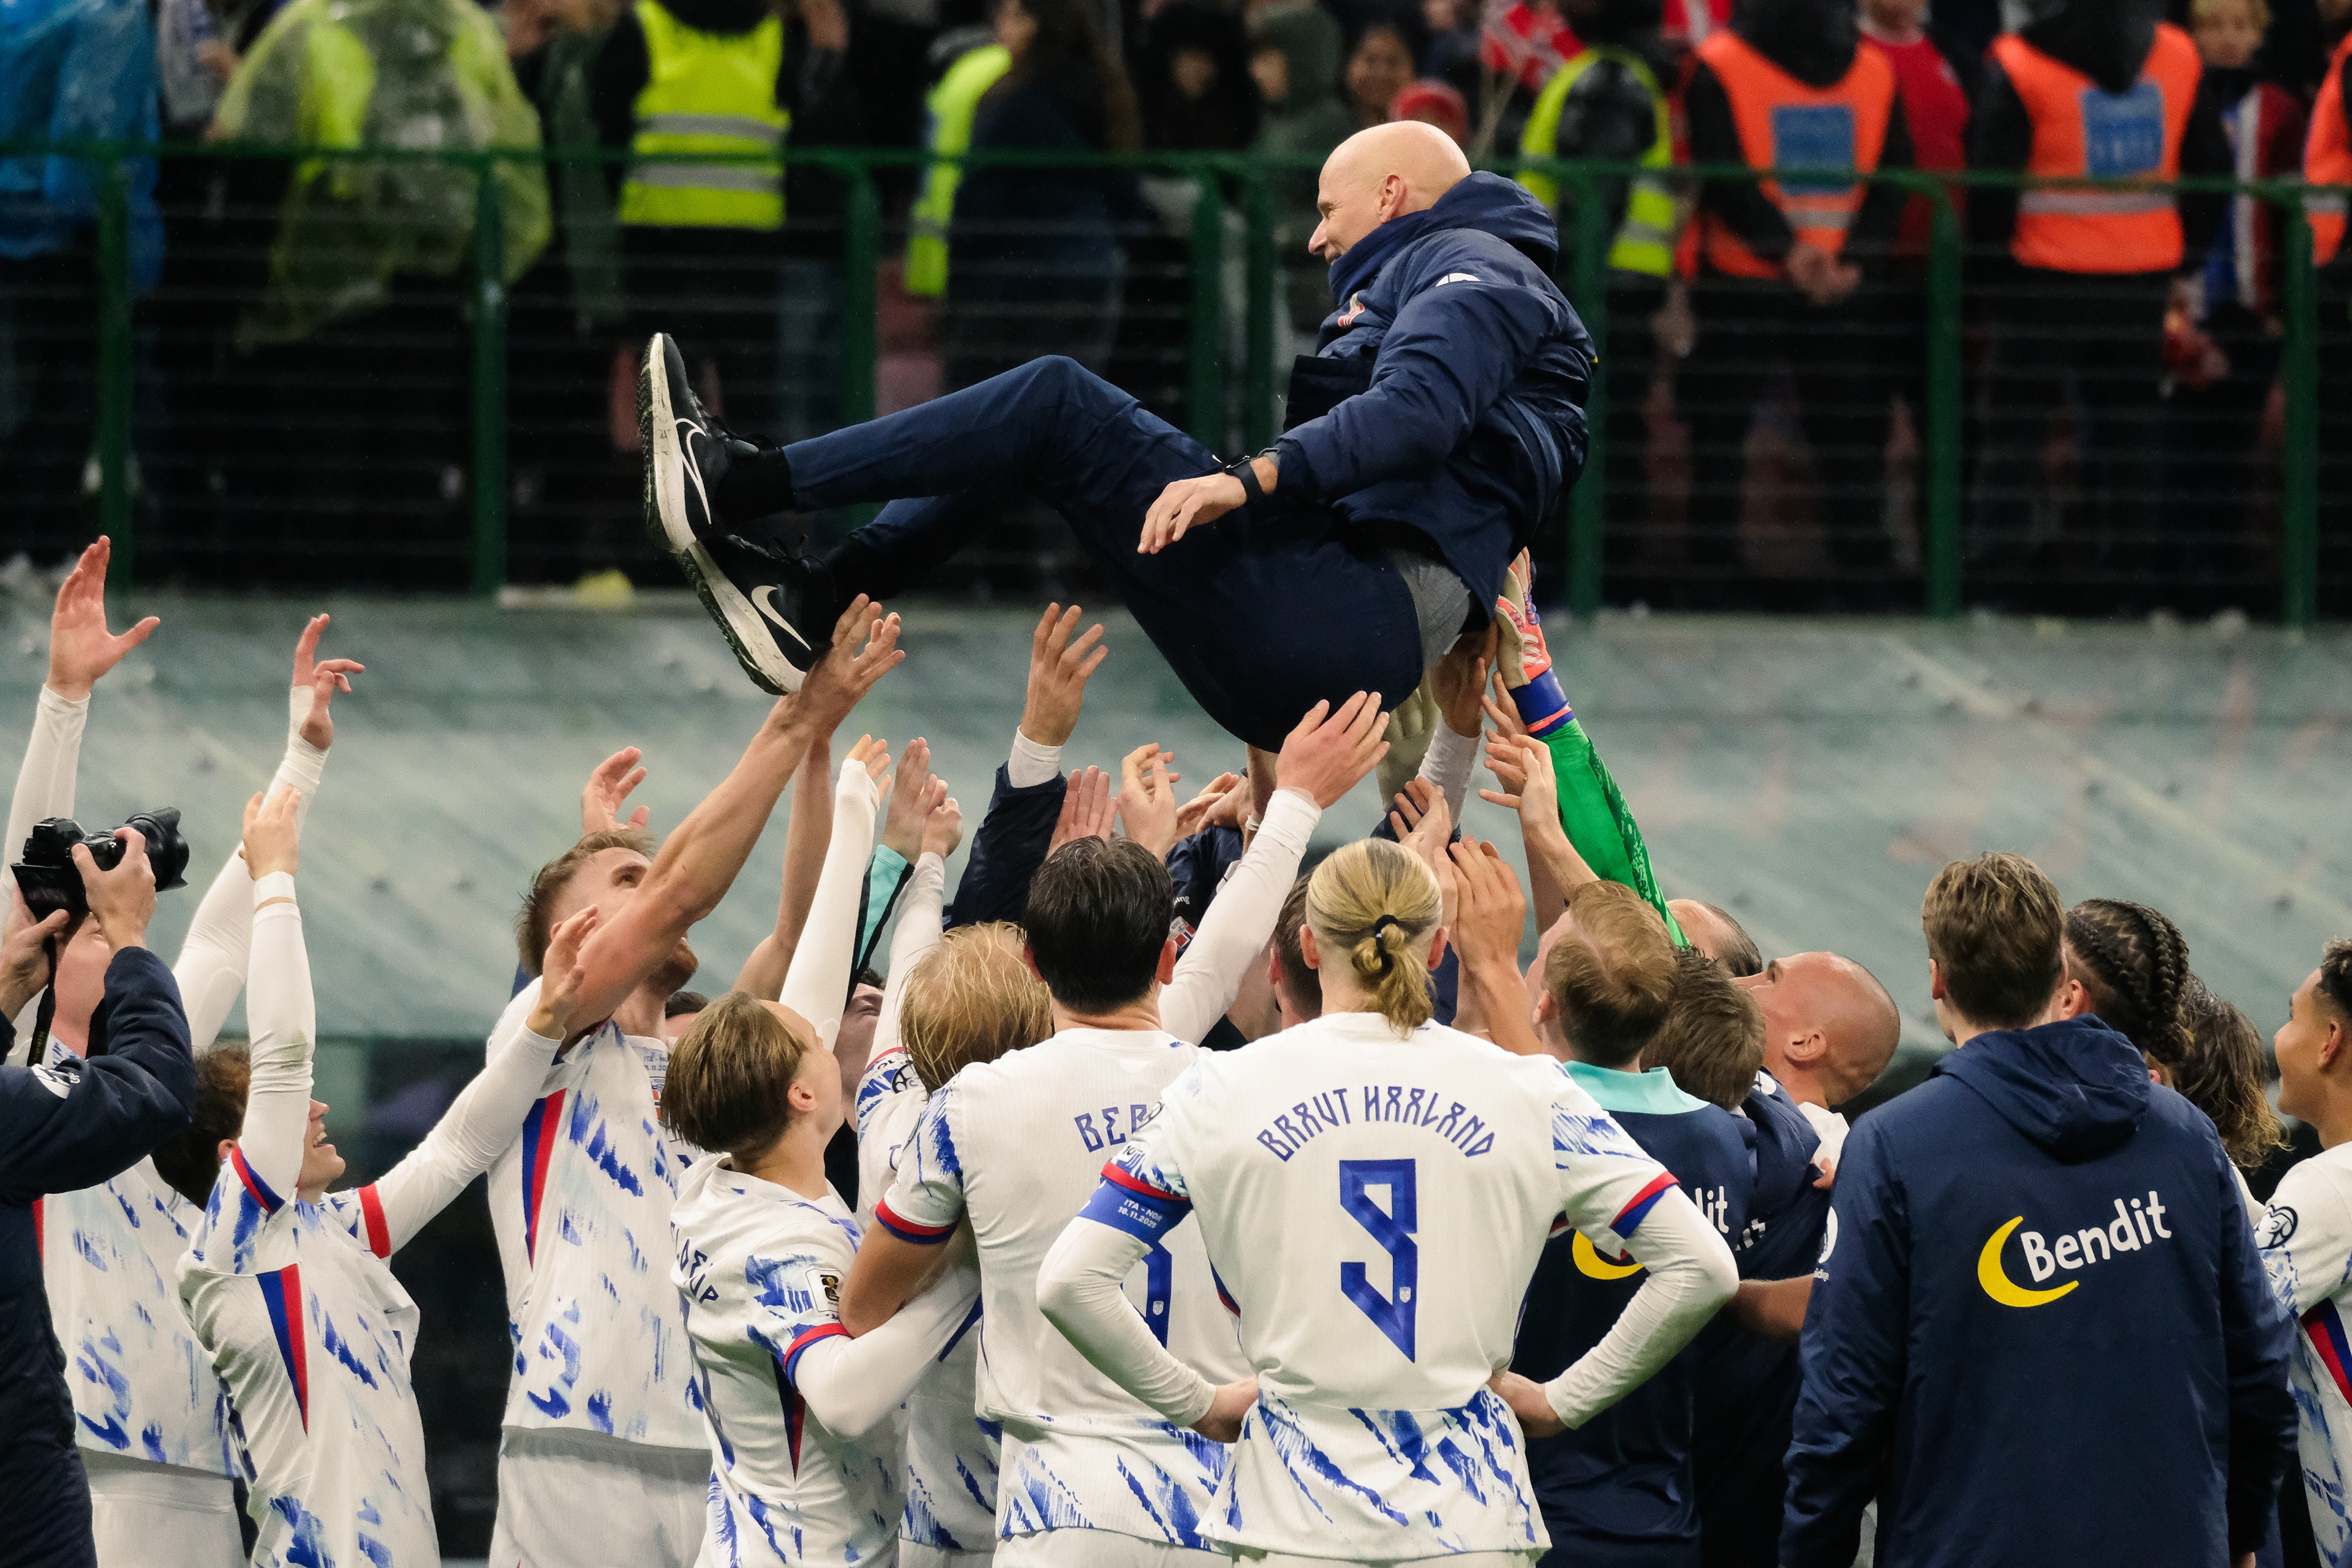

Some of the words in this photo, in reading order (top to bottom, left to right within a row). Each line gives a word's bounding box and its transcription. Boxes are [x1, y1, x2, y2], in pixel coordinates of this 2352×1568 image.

[1074, 1104, 1148, 1153] BER
[1257, 1086, 1351, 1162] BRAUT
[1363, 1085, 1495, 1158] HAALAND
[1124, 1199, 1139, 1210] ITA
[2019, 1190, 2173, 1283] Bendit
[1339, 1158, 1419, 1363] 9
